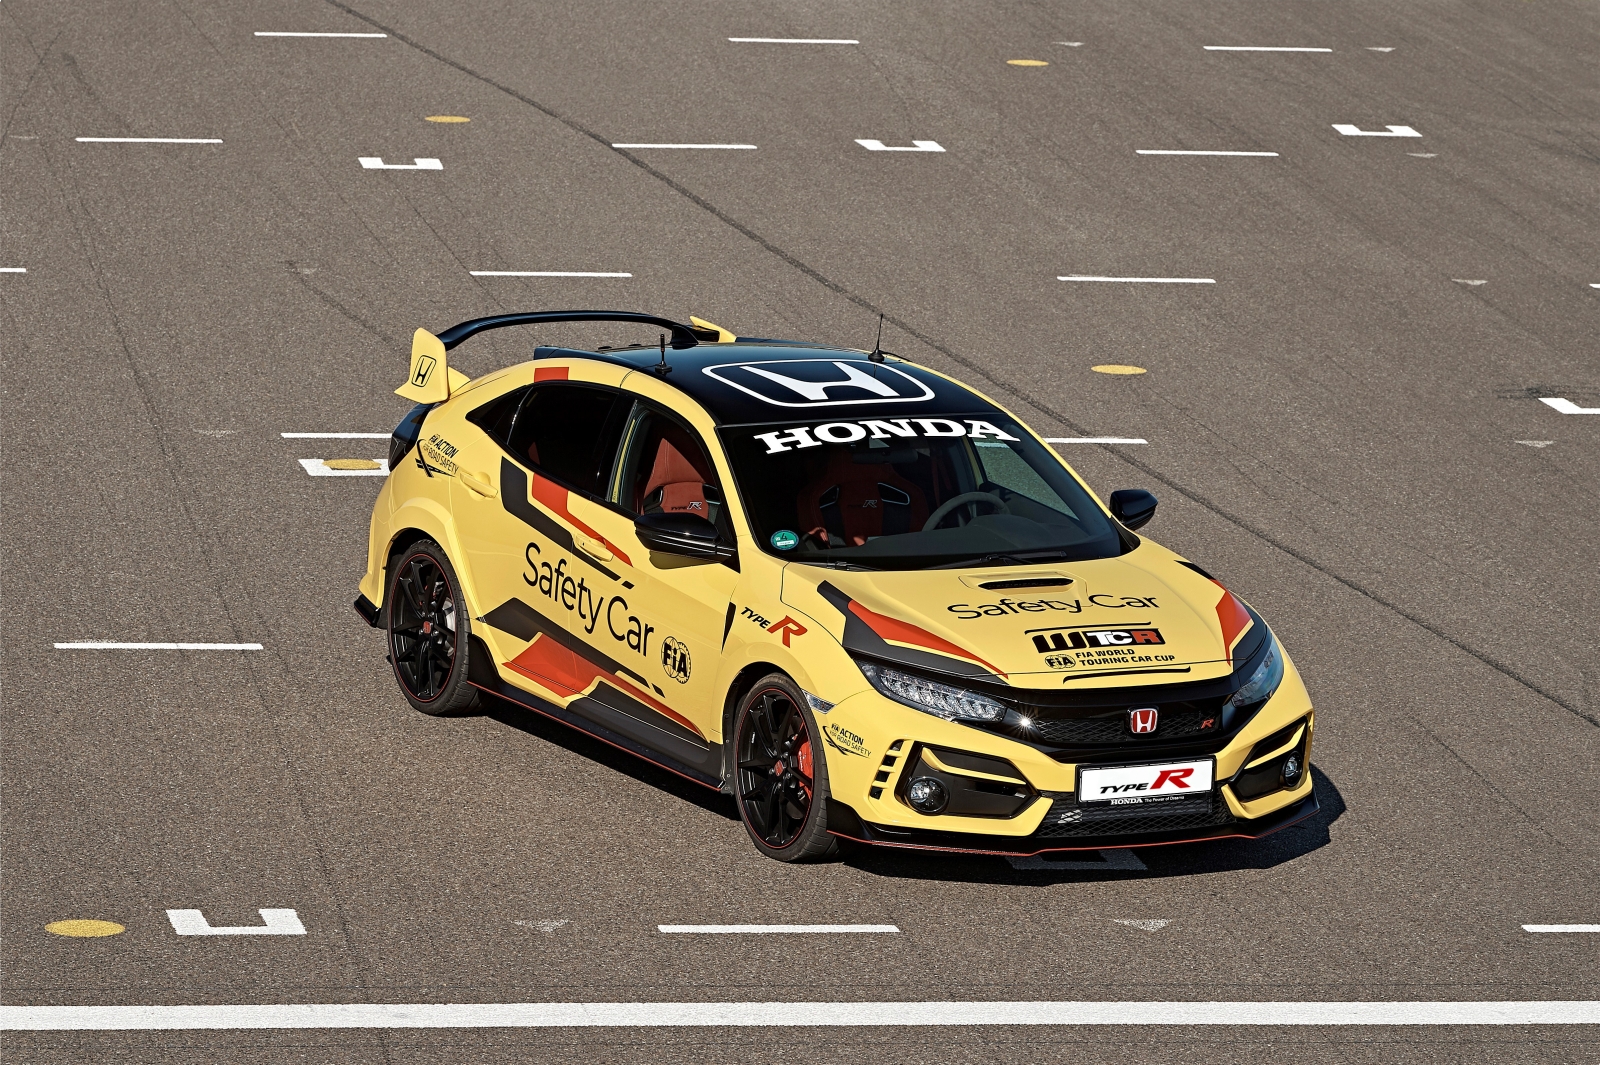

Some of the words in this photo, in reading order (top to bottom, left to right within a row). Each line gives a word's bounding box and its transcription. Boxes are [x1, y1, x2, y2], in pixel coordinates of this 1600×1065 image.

[754, 419, 1021, 454] HONDA
[434, 439, 459, 458] ACTION
[428, 447, 441, 462] ROAD
[440, 456, 459, 474] SAFETY
[687, 501, 702, 510] R
[523, 542, 604, 634] Safety
[607, 595, 654, 657] Car
[947, 598, 1083, 619] Safety
[1088, 594, 1160, 609] Car
[740, 606, 771, 629] TYPE
[766, 614, 808, 648] R
[1079, 656, 1129, 666] TOURING
[1131, 655, 1153, 663] CAR
[1155, 654, 1175, 662] CUP
[1095, 648, 1135, 657] WORLD
[1201, 719, 1214, 729] R
[837, 735, 851, 747] ROAD
[851, 743, 871, 757] SAFETY
[840, 728, 864, 745] ACTION
[1100, 783, 1149, 794] TYPE
[1149, 768, 1194, 790] R
[1110, 797, 1143, 805] HONDA
